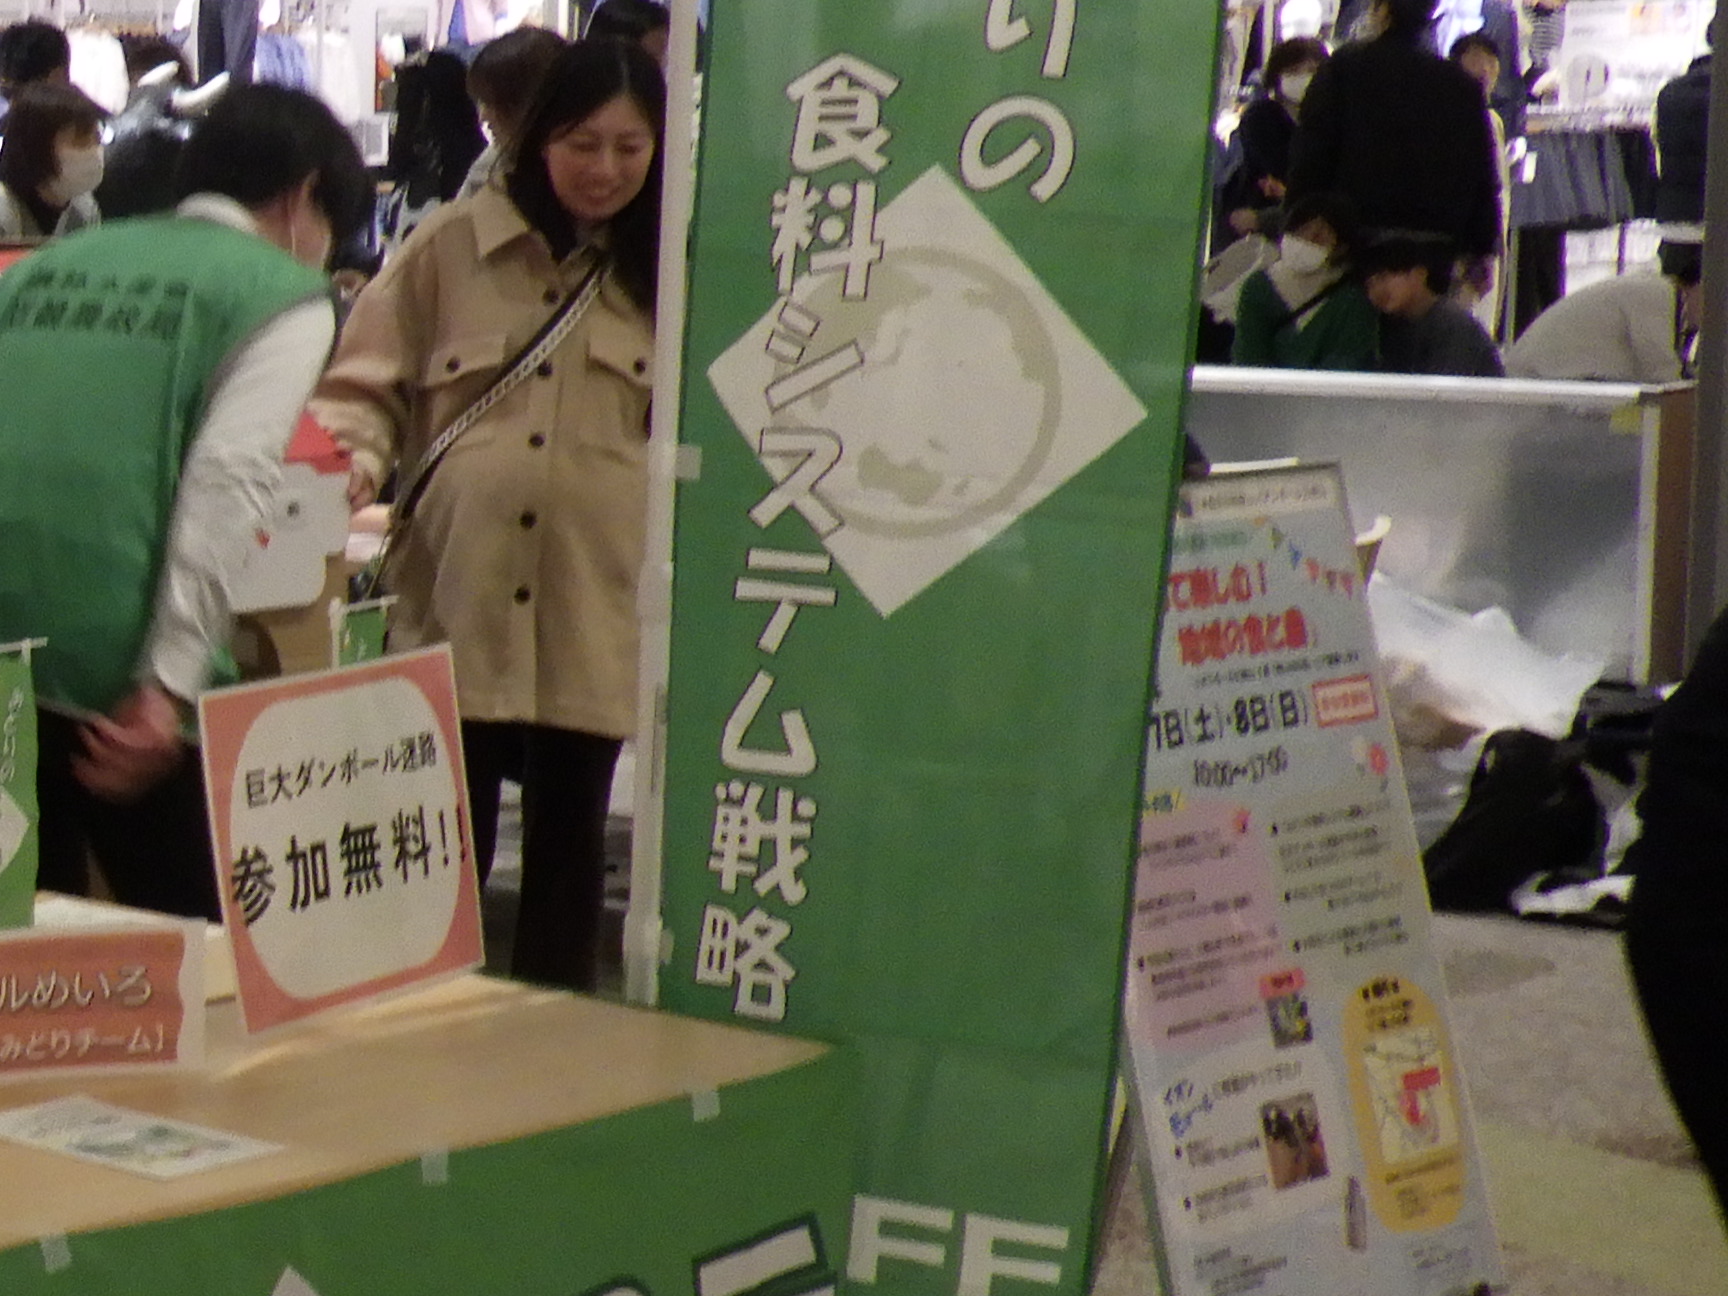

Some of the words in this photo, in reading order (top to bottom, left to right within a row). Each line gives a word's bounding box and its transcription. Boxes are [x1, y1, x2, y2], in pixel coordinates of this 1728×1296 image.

[244, 731, 438, 808] 巨大ダンボール迷路
[694, 50, 901, 1023] 食料システム戦略
